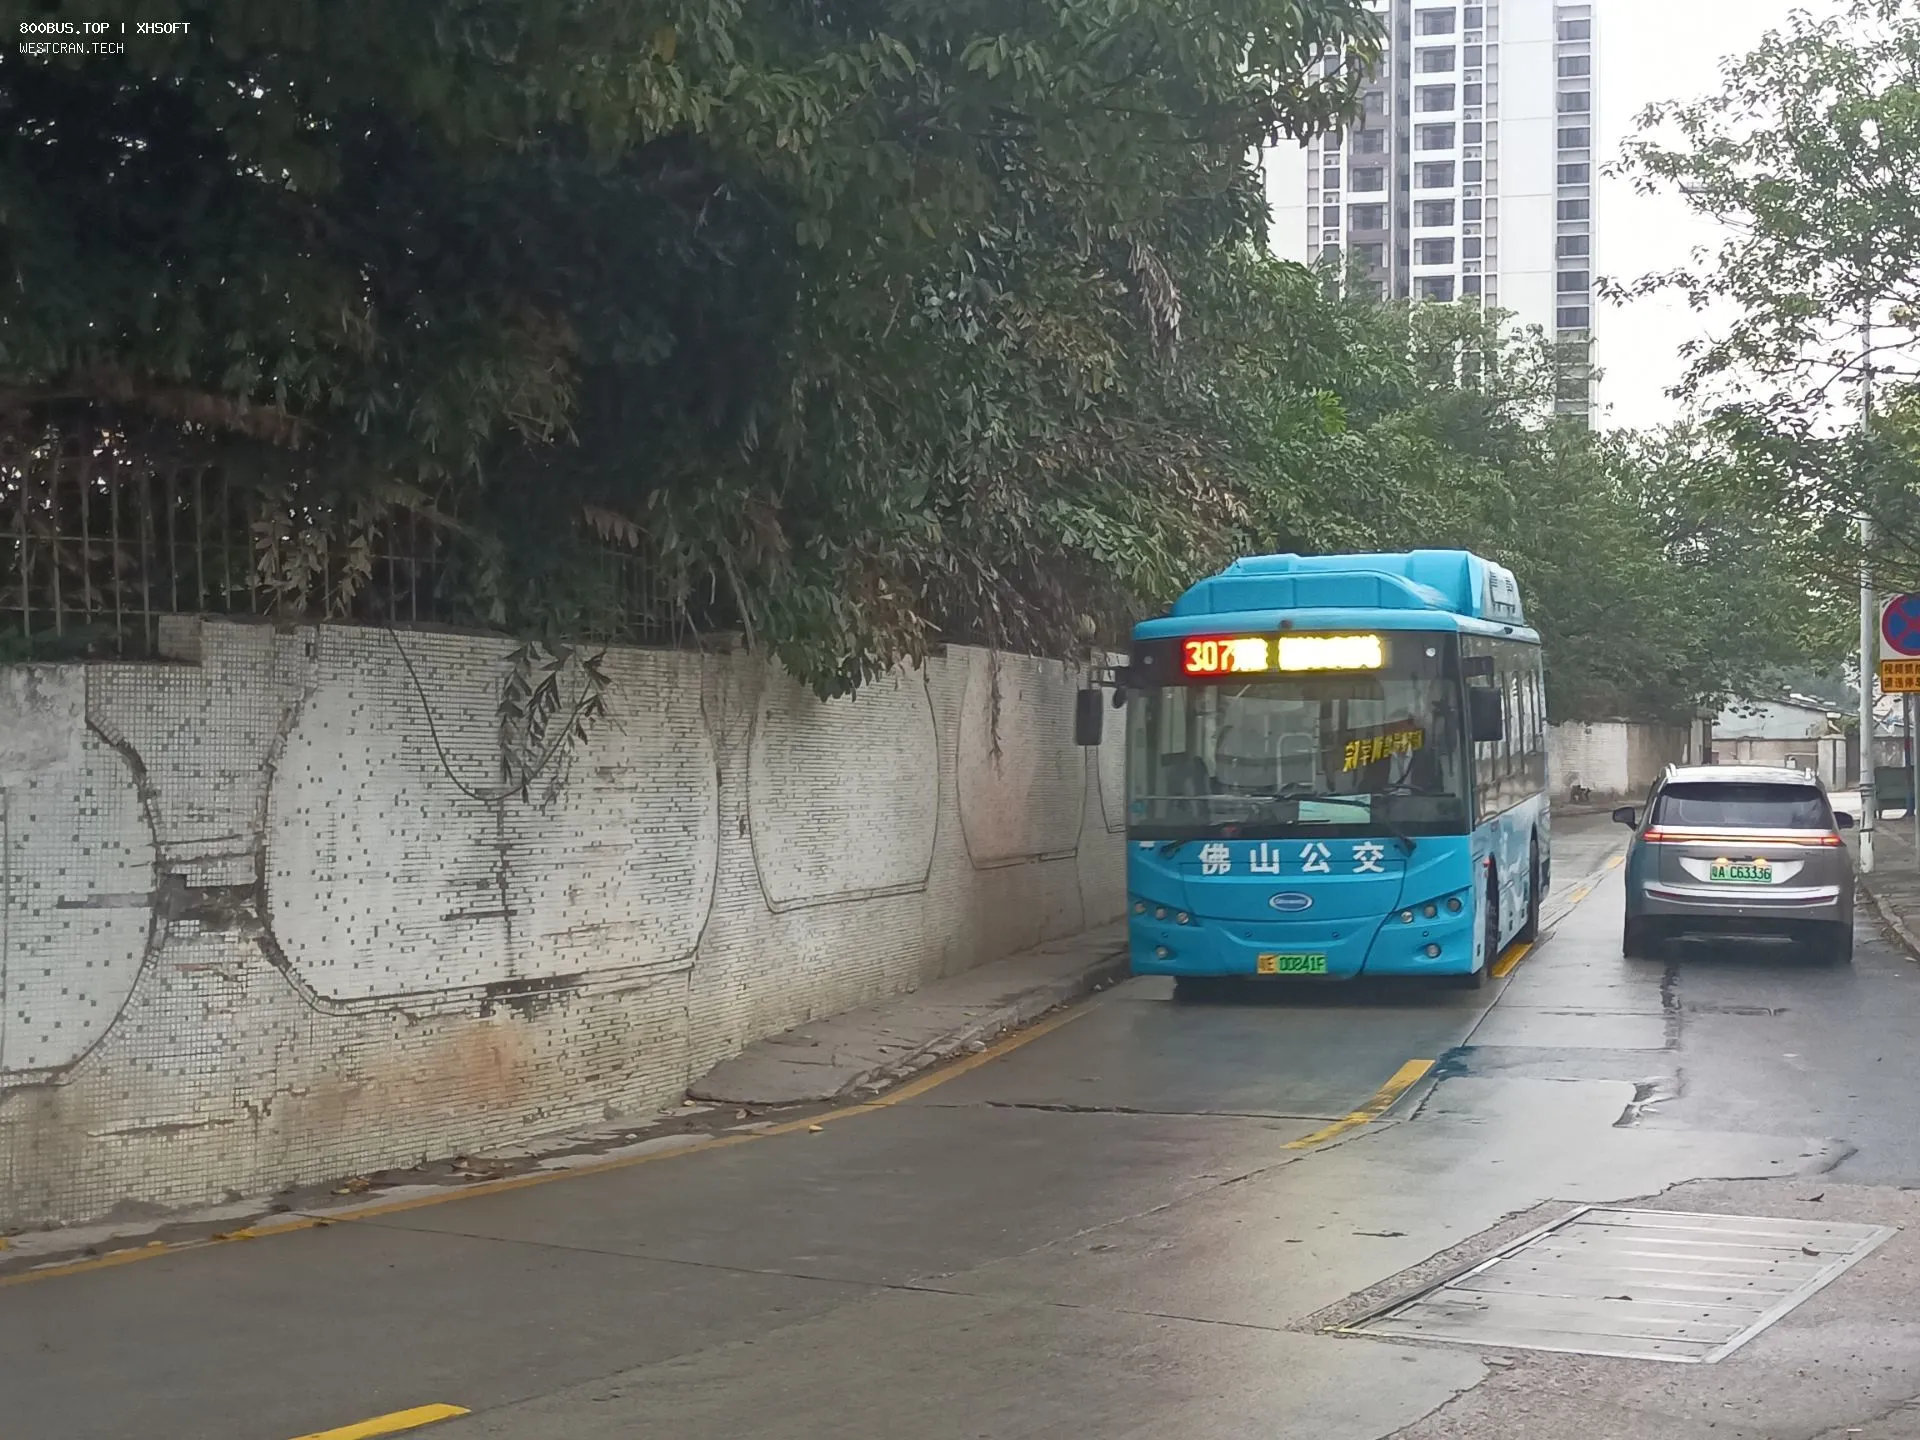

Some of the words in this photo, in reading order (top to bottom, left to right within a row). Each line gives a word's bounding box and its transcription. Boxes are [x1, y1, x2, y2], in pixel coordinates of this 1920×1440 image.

[1198, 841, 1385, 875] 佛山公交
[1730, 865, 1772, 880] C63336
